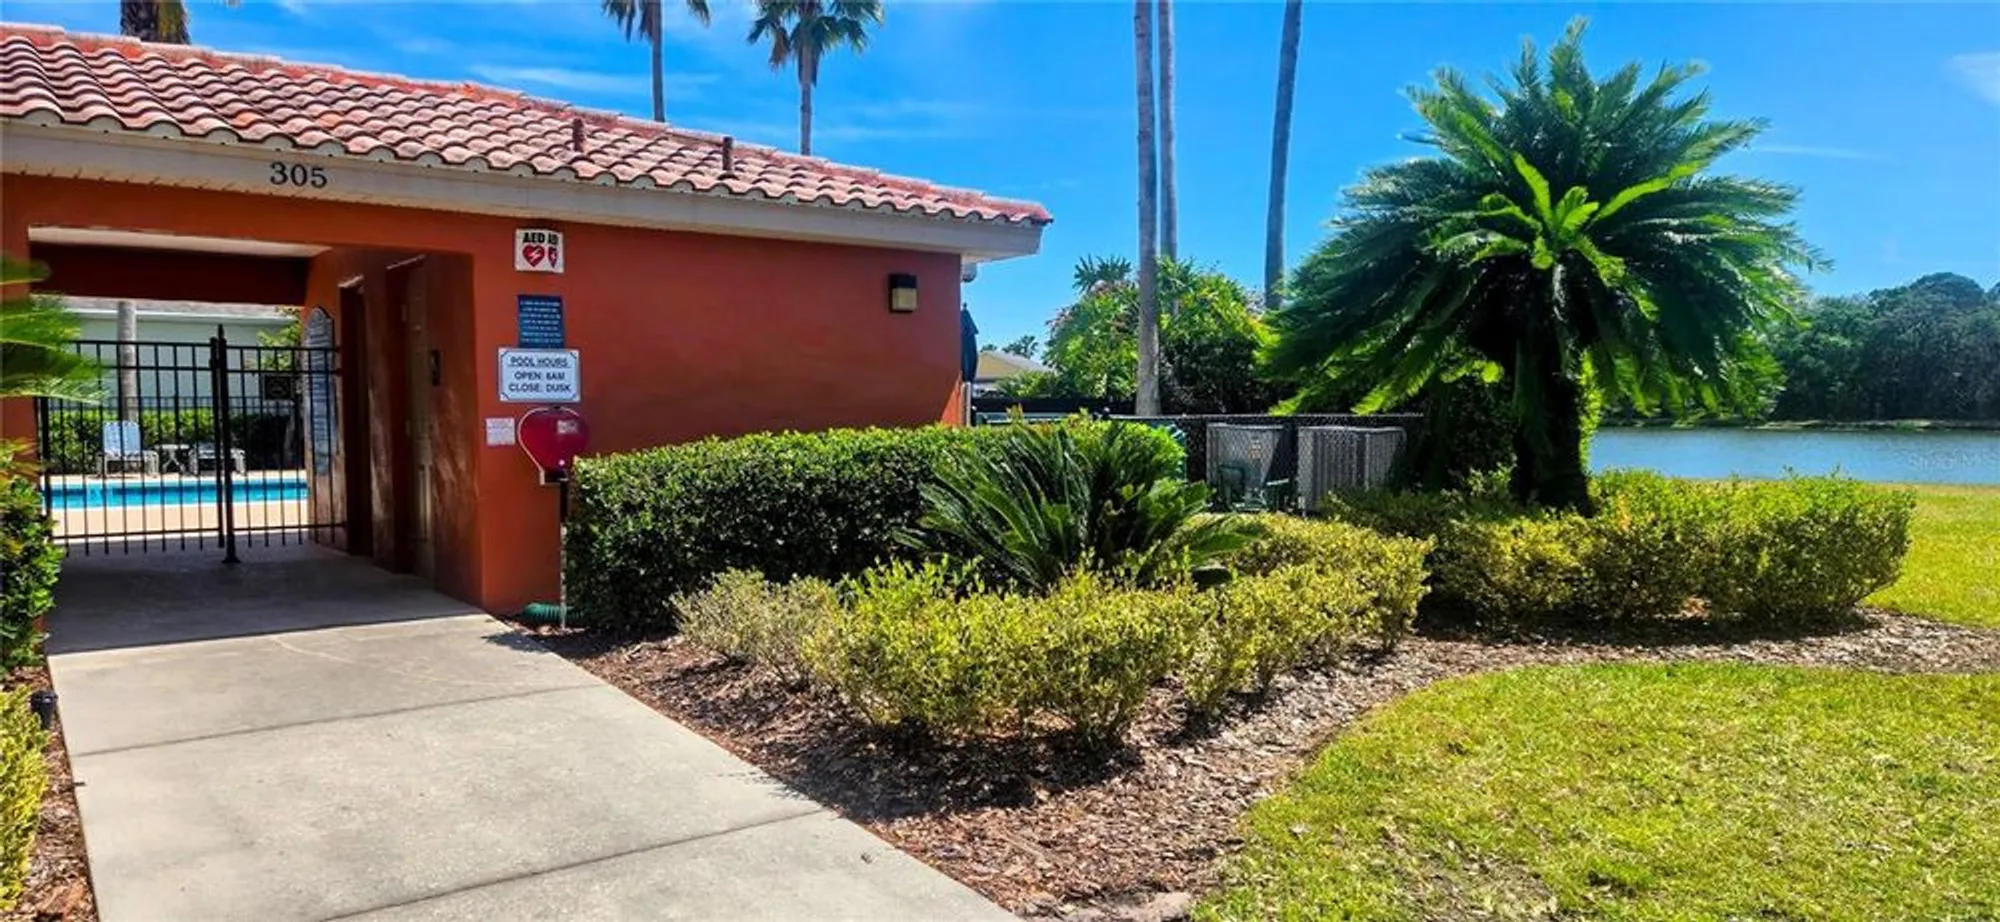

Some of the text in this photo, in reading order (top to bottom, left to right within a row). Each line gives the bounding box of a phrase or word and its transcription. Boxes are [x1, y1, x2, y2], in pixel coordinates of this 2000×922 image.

[270, 161, 328, 188] 305
[523, 232, 545, 243] AED
[510, 356, 569, 368] POOL HOURS
[545, 383, 571, 393] DUSK
